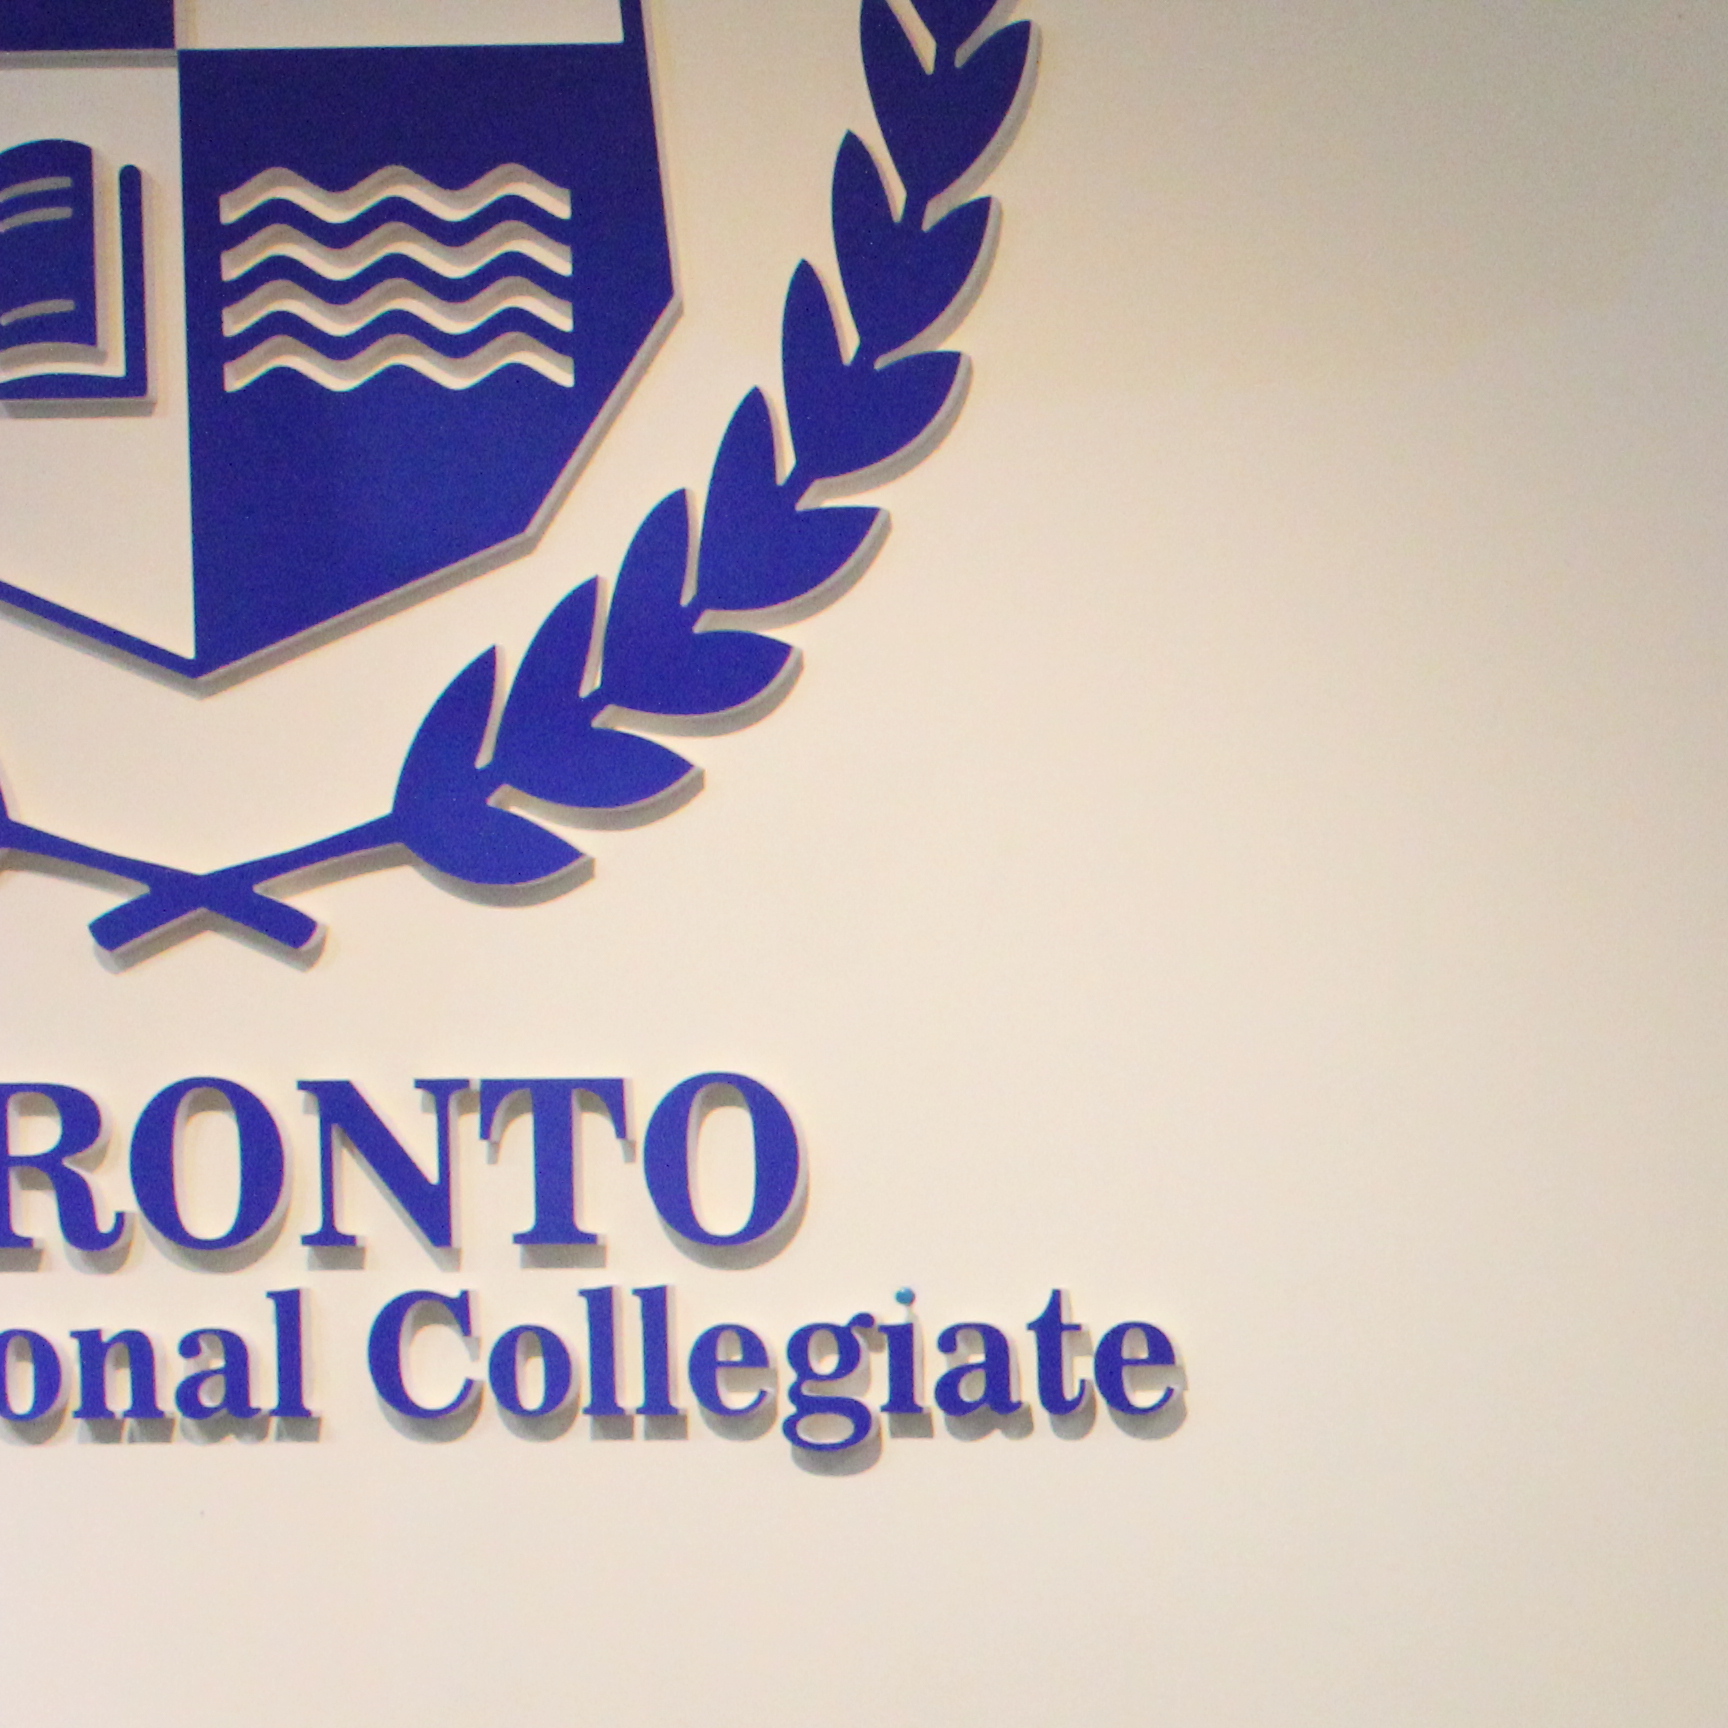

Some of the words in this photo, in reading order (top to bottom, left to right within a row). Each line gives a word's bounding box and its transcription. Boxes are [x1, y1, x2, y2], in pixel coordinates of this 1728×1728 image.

[0, 1071, 802, 1252] RONTO
[0, 1287, 313, 1421] onal
[367, 1284, 1179, 1452] Collegiate
